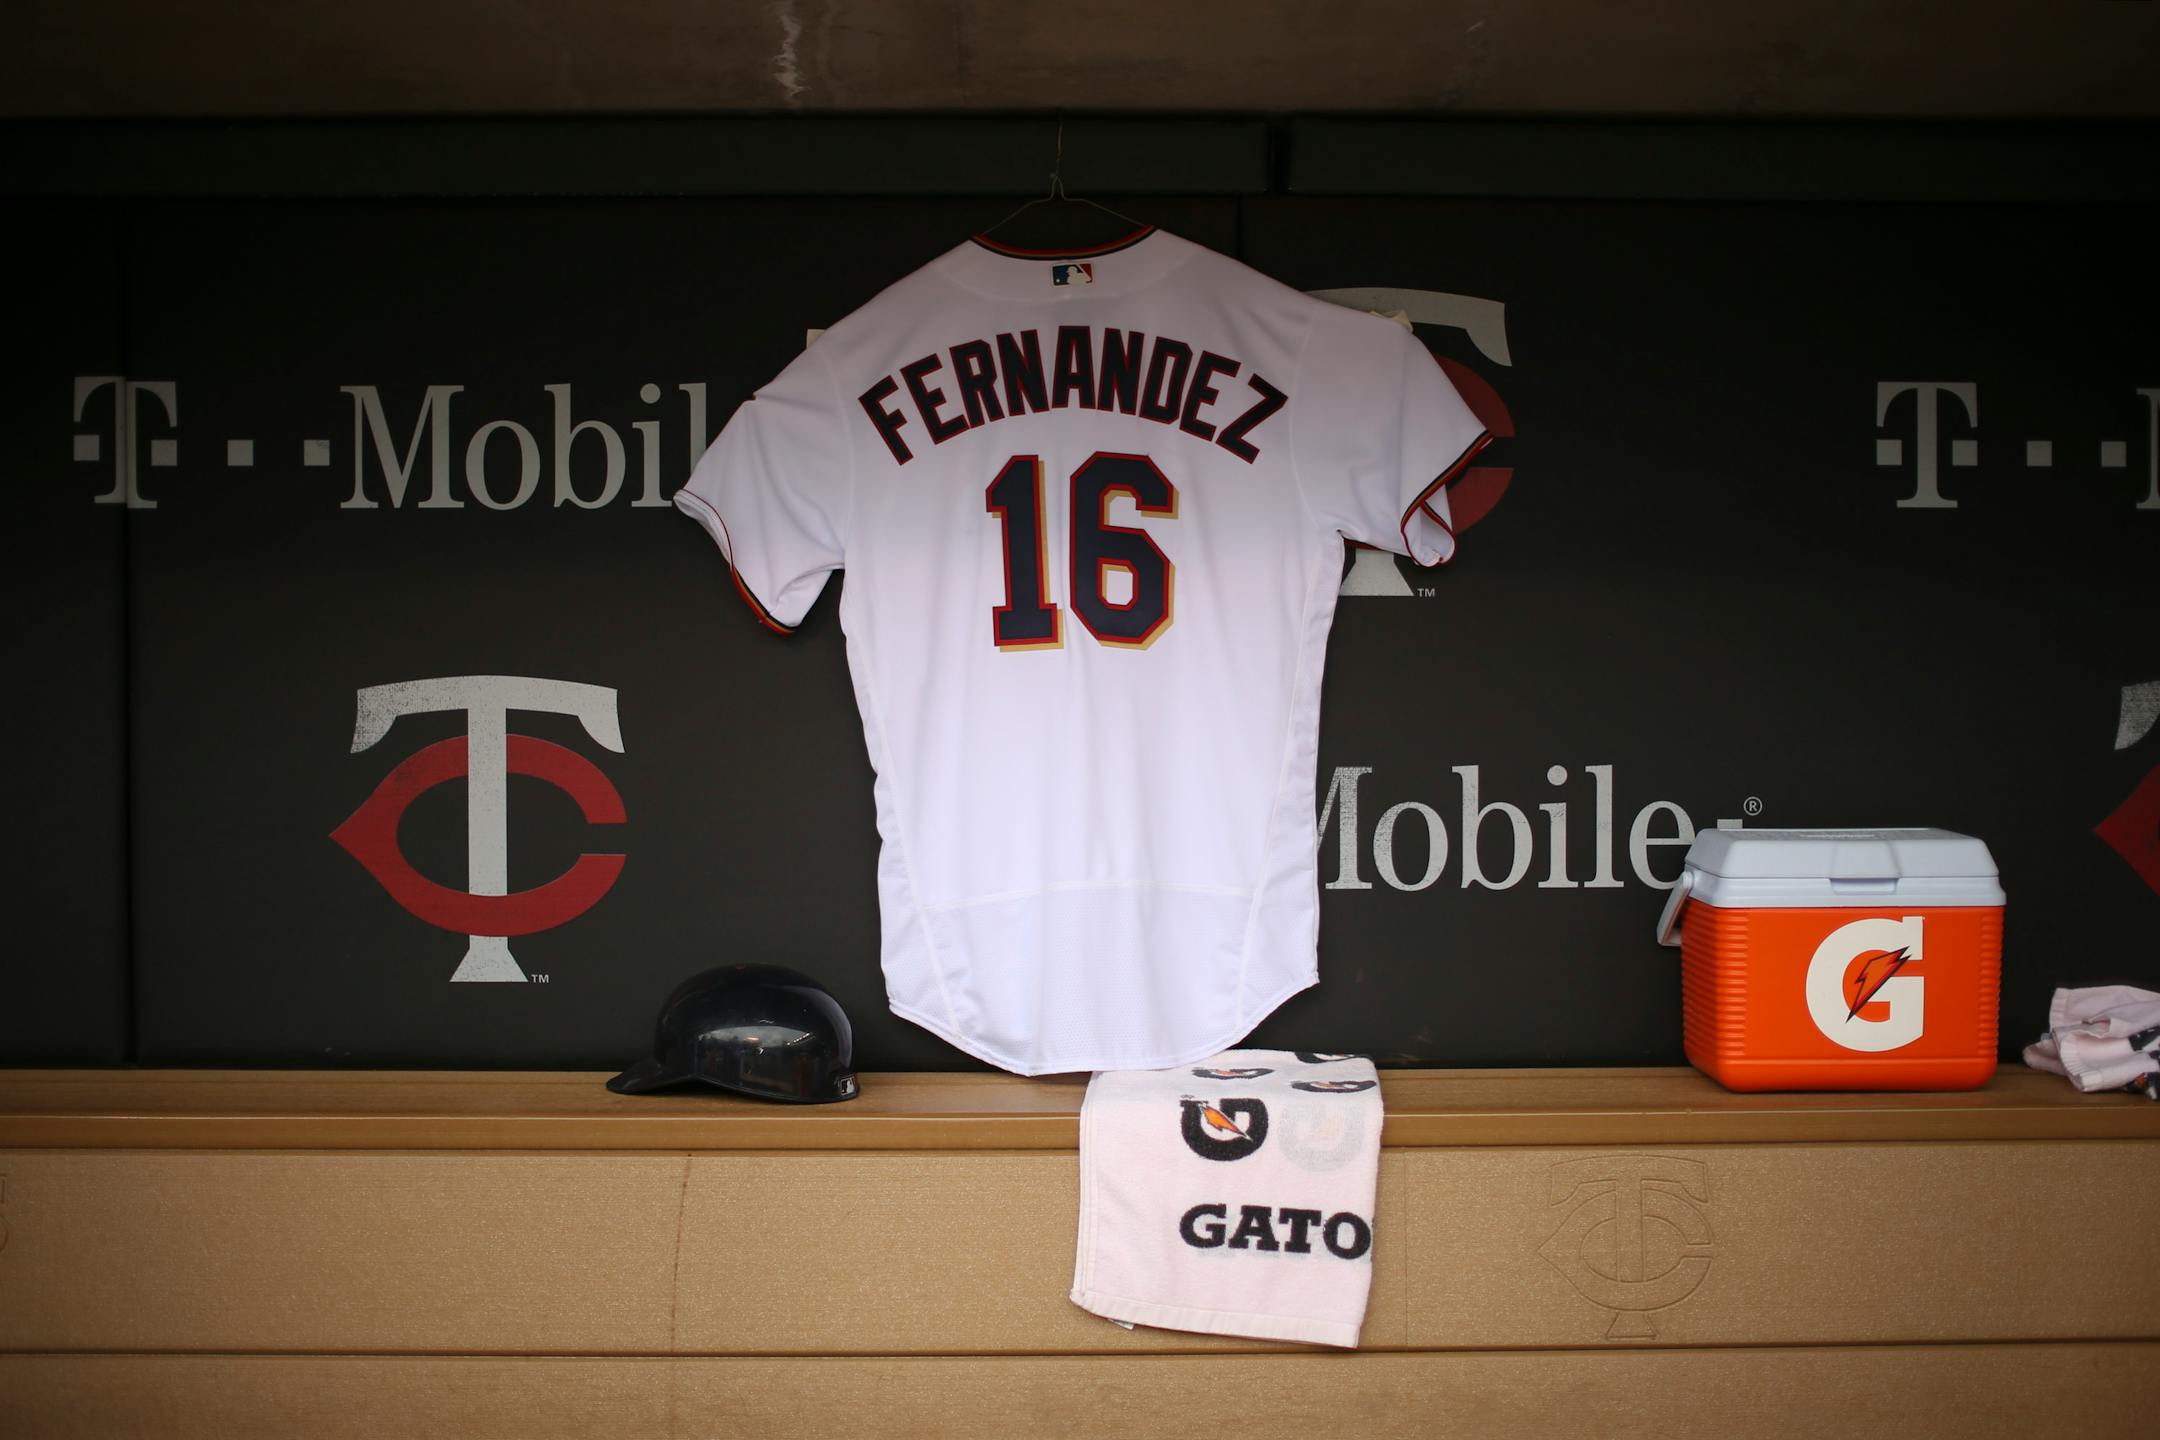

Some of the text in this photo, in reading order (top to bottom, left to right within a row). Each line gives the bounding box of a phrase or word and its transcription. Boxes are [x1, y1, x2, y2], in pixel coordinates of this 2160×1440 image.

[858, 325, 1289, 466] FERNANDEZ
[985, 451, 1180, 652] 16
[1805, 915, 1925, 1053] G
[1179, 1203, 1372, 1260] GATO
